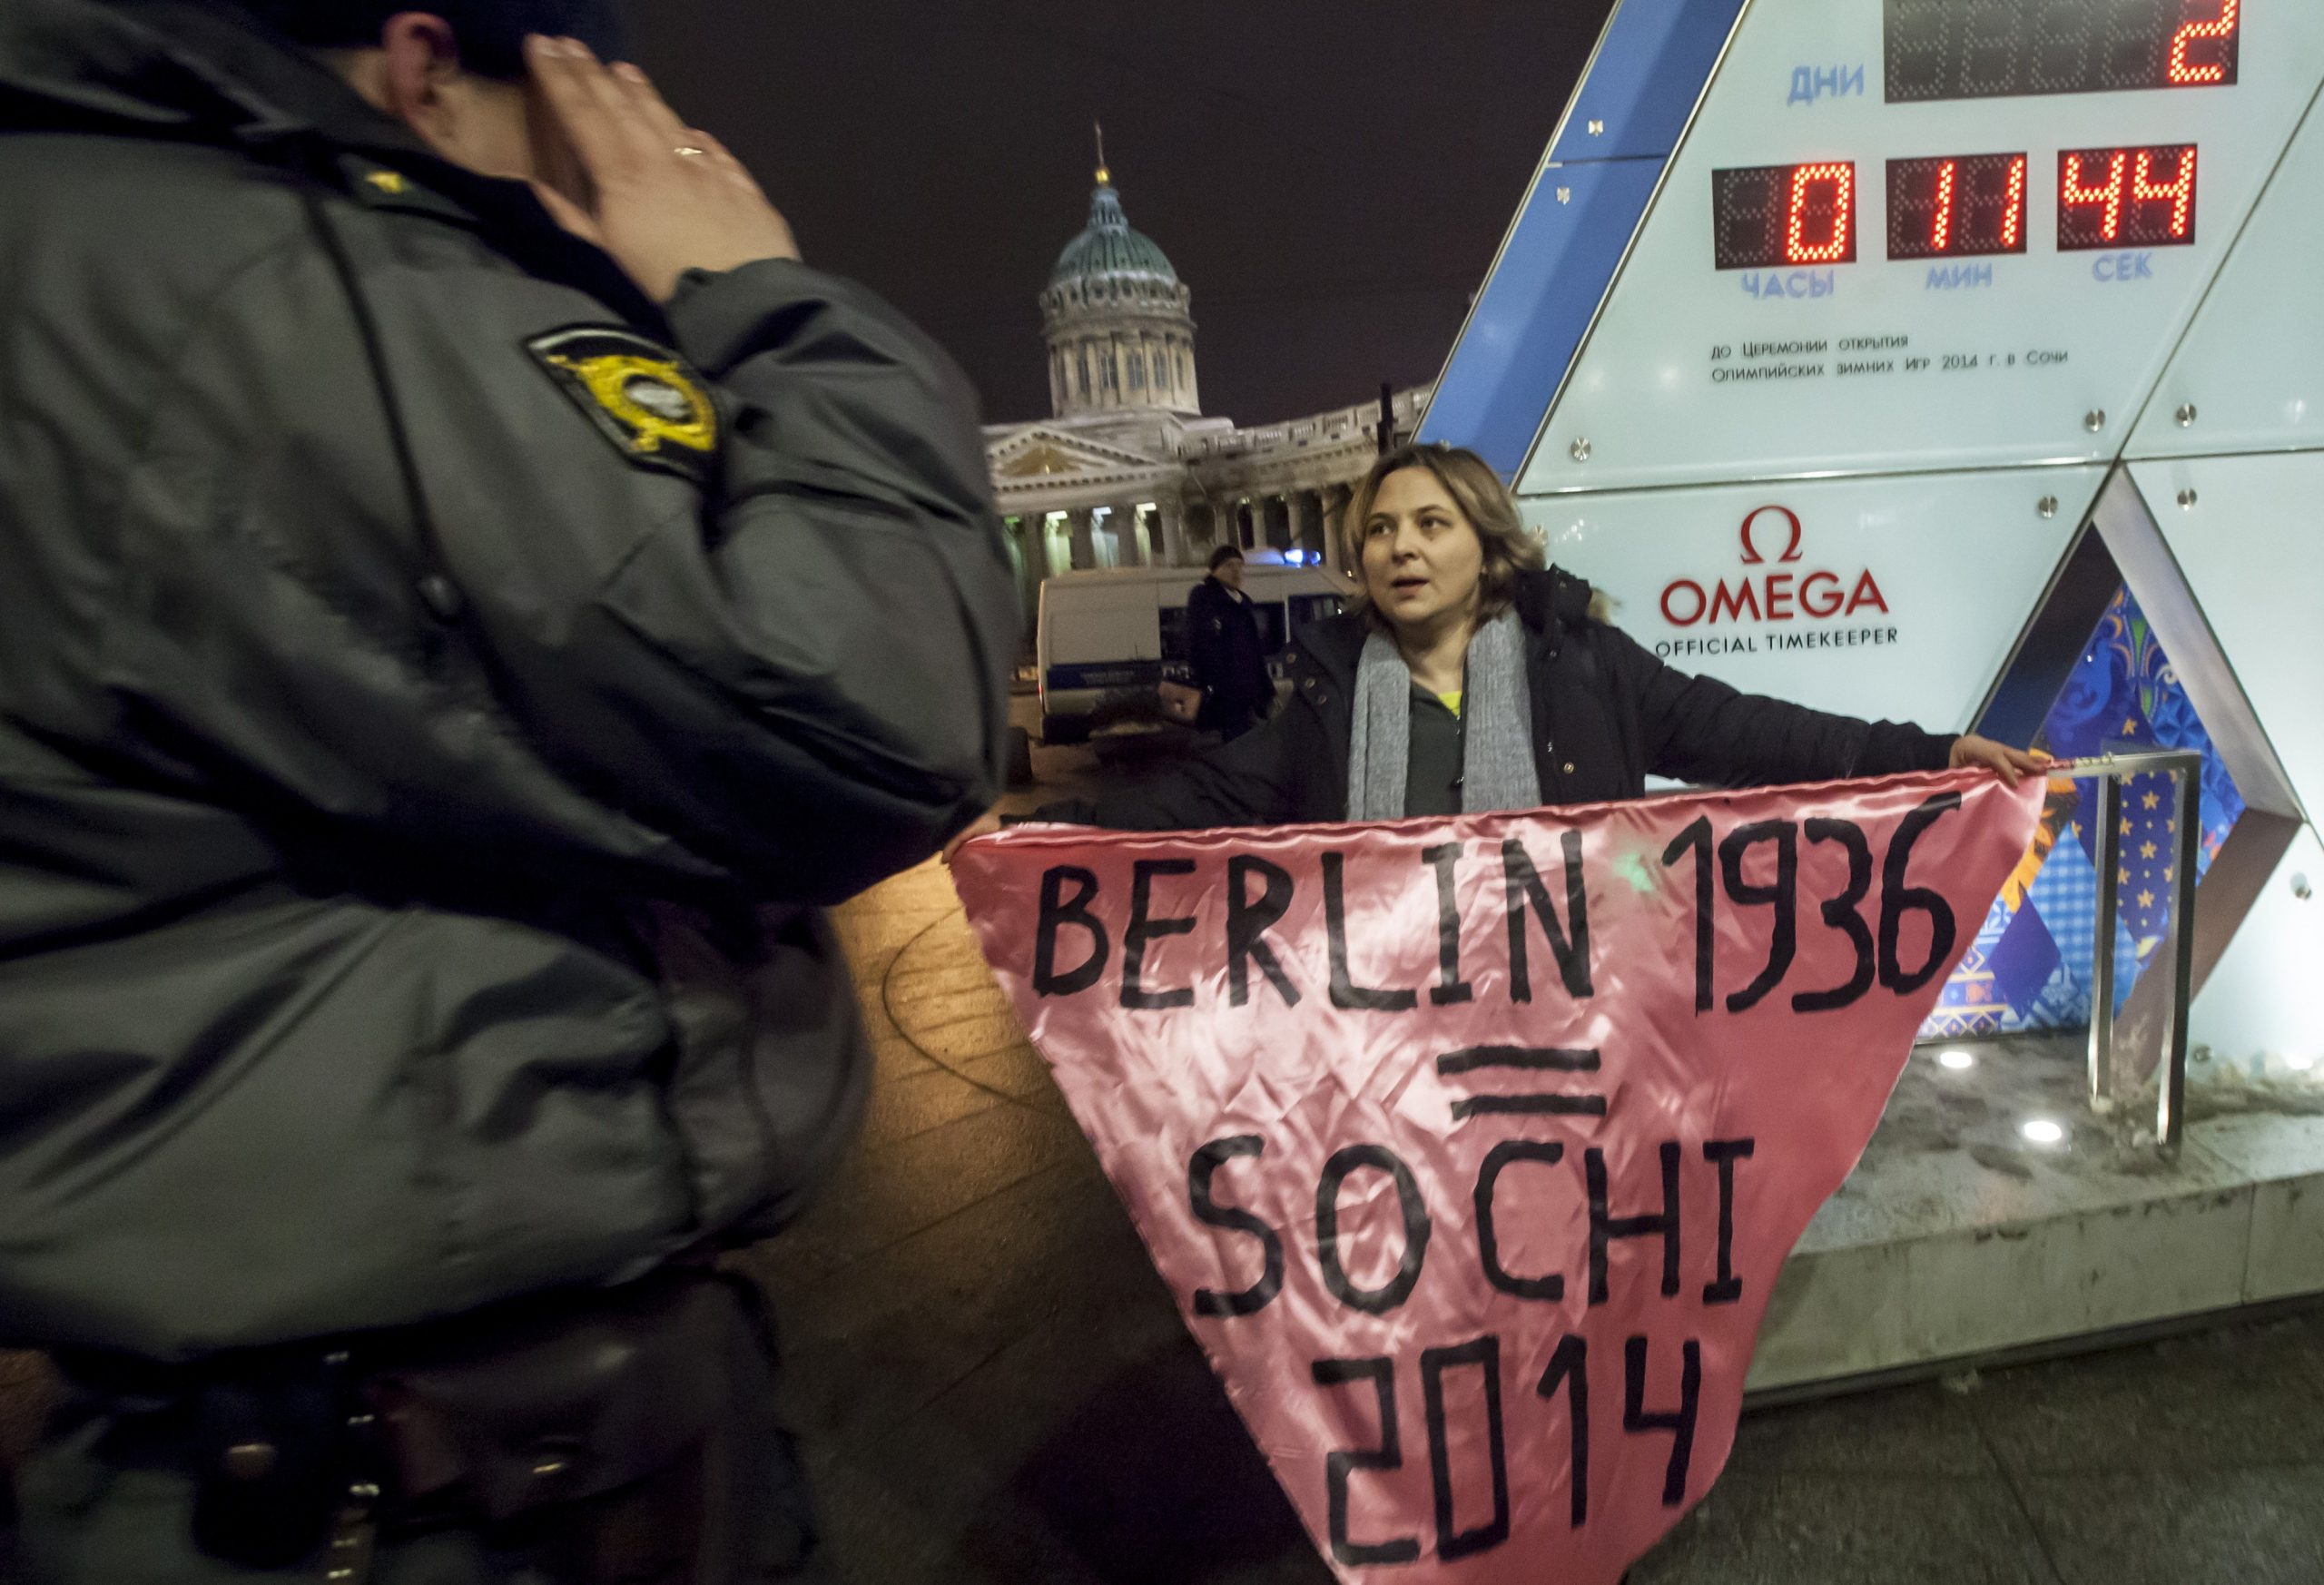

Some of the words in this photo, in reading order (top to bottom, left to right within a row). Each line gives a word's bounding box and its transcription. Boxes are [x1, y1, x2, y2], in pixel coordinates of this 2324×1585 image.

[2168, 0, 2237, 84] 2
[1786, 63, 1865, 107] ДНИ
[1786, 162, 1852, 262] 0
[1932, 156, 2025, 251] 11
[2062, 148, 2197, 240] 44
[1741, 269, 1835, 300] ЧАСЫ
[1925, 262, 1993, 290] МИН
[2092, 252, 2152, 282] СЕК
[1942, 353, 1979, 370] 2014
[1660, 566, 1889, 627] OMEGA
[1655, 635, 1758, 657] OFFICIAL
[1766, 626, 1897, 651] TIMEKEEPER
[1032, 830, 1593, 1013] BERLIN
[1661, 791, 1961, 1017] 1936
[1187, 1134, 1756, 1319] SOCHI
[1311, 1334, 1703, 1567] 2014
